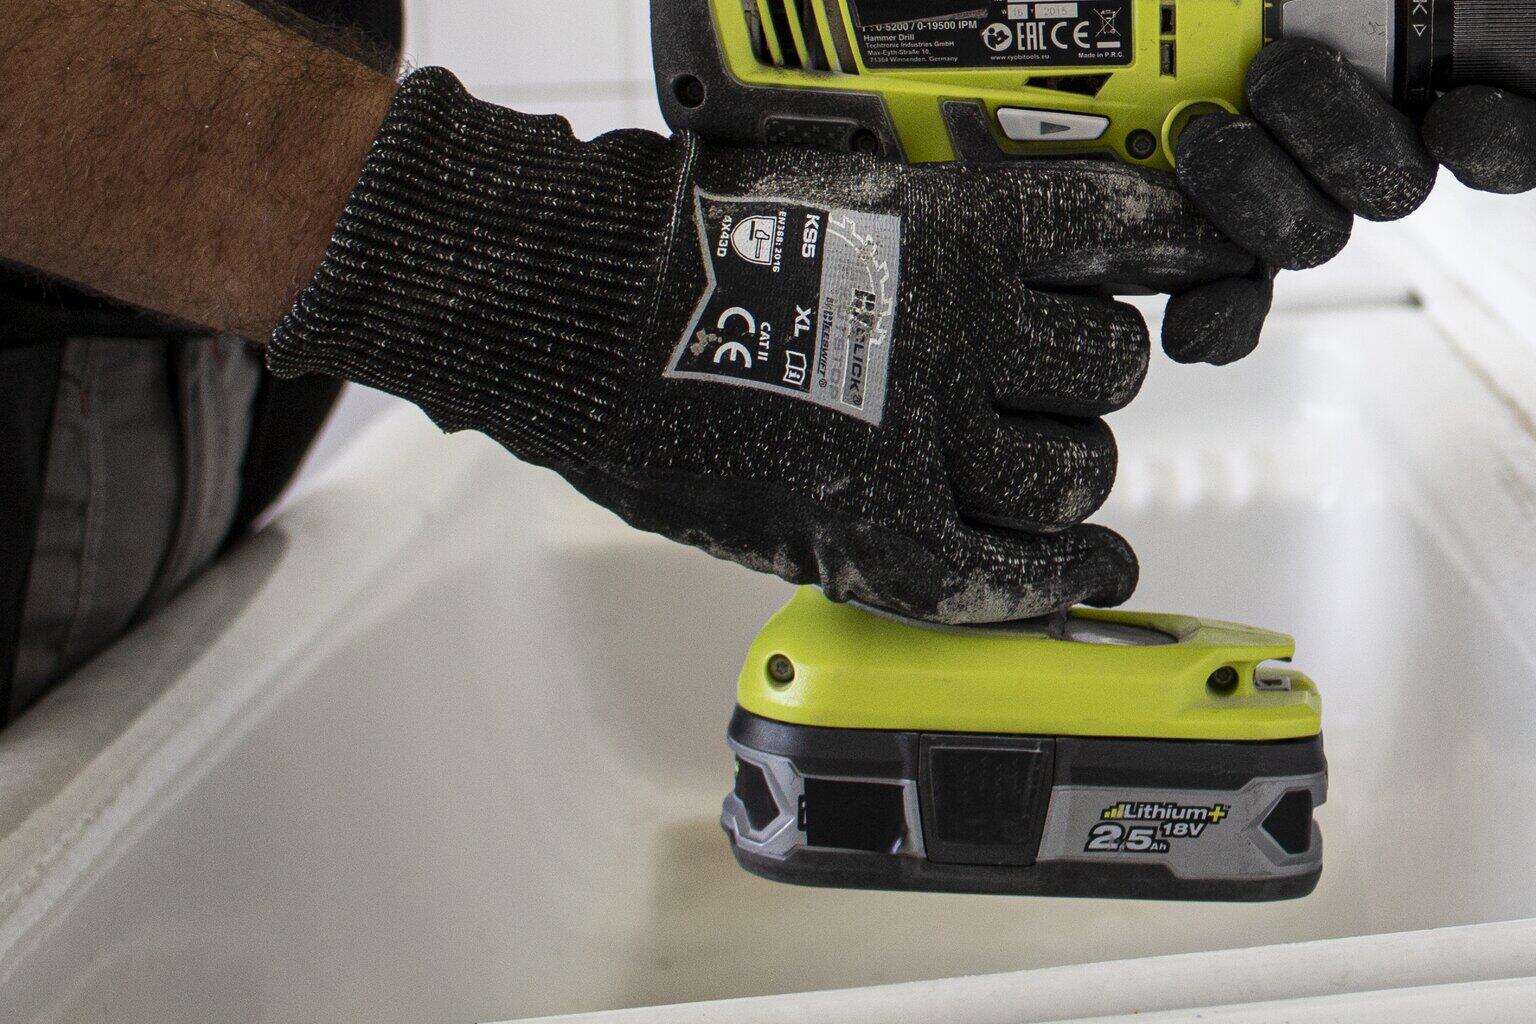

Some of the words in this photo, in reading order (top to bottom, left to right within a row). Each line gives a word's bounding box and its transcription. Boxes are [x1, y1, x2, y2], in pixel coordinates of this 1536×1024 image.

[917, 21, 956, 30] 0-19500
[958, 20, 977, 29] IPM
[863, 34, 896, 42] Hammer
[898, 33, 915, 41] Drill
[928, 56, 959, 64] Germany
[802, 213, 821, 259] KS5
[793, 304, 812, 338] XL
[758, 321, 772, 350] CAT
[1163, 822, 1204, 837] 18V
